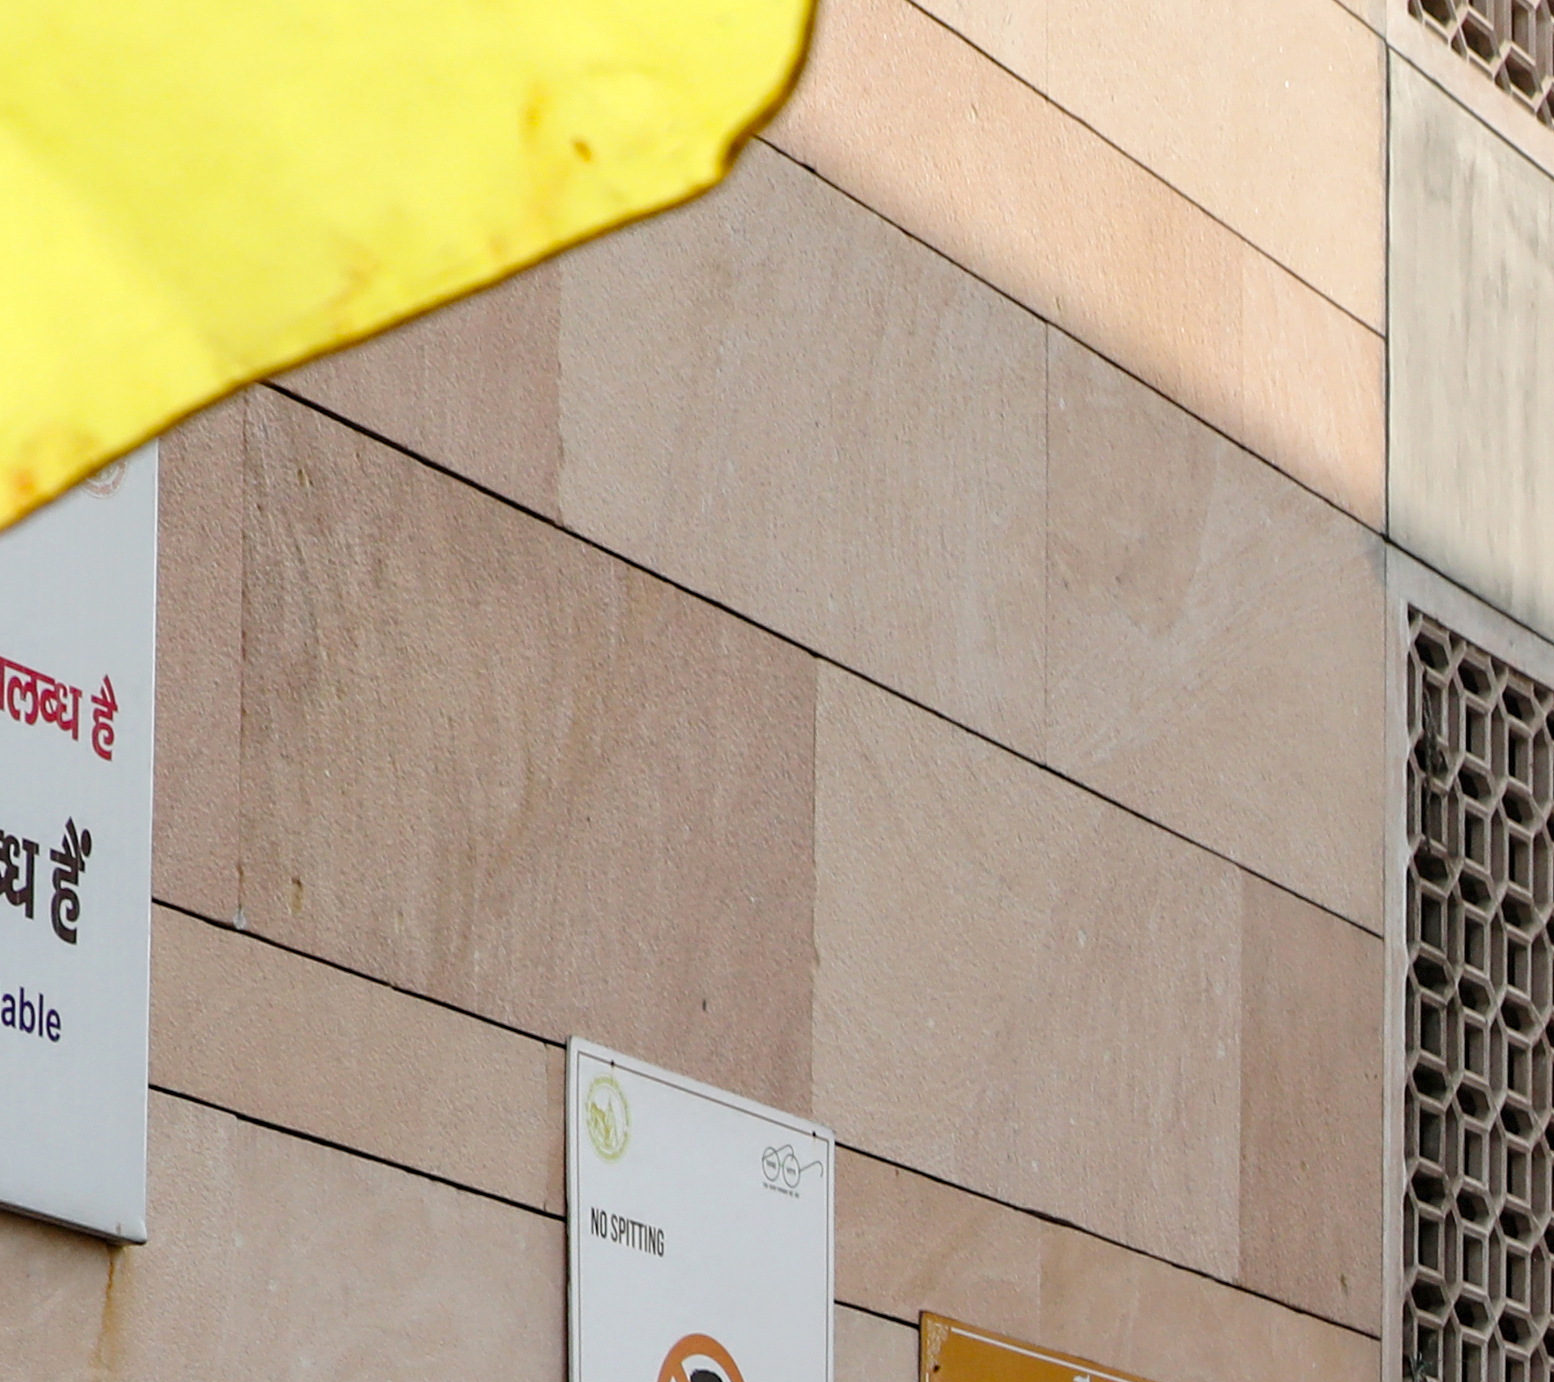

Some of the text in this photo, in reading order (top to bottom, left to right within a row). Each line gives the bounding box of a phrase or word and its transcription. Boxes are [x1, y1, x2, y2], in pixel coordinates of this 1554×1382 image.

[91, 674, 118, 761] है
[50, 817, 92, 945] हैं
[590, 1207, 665, 1258] NO SPITTING
